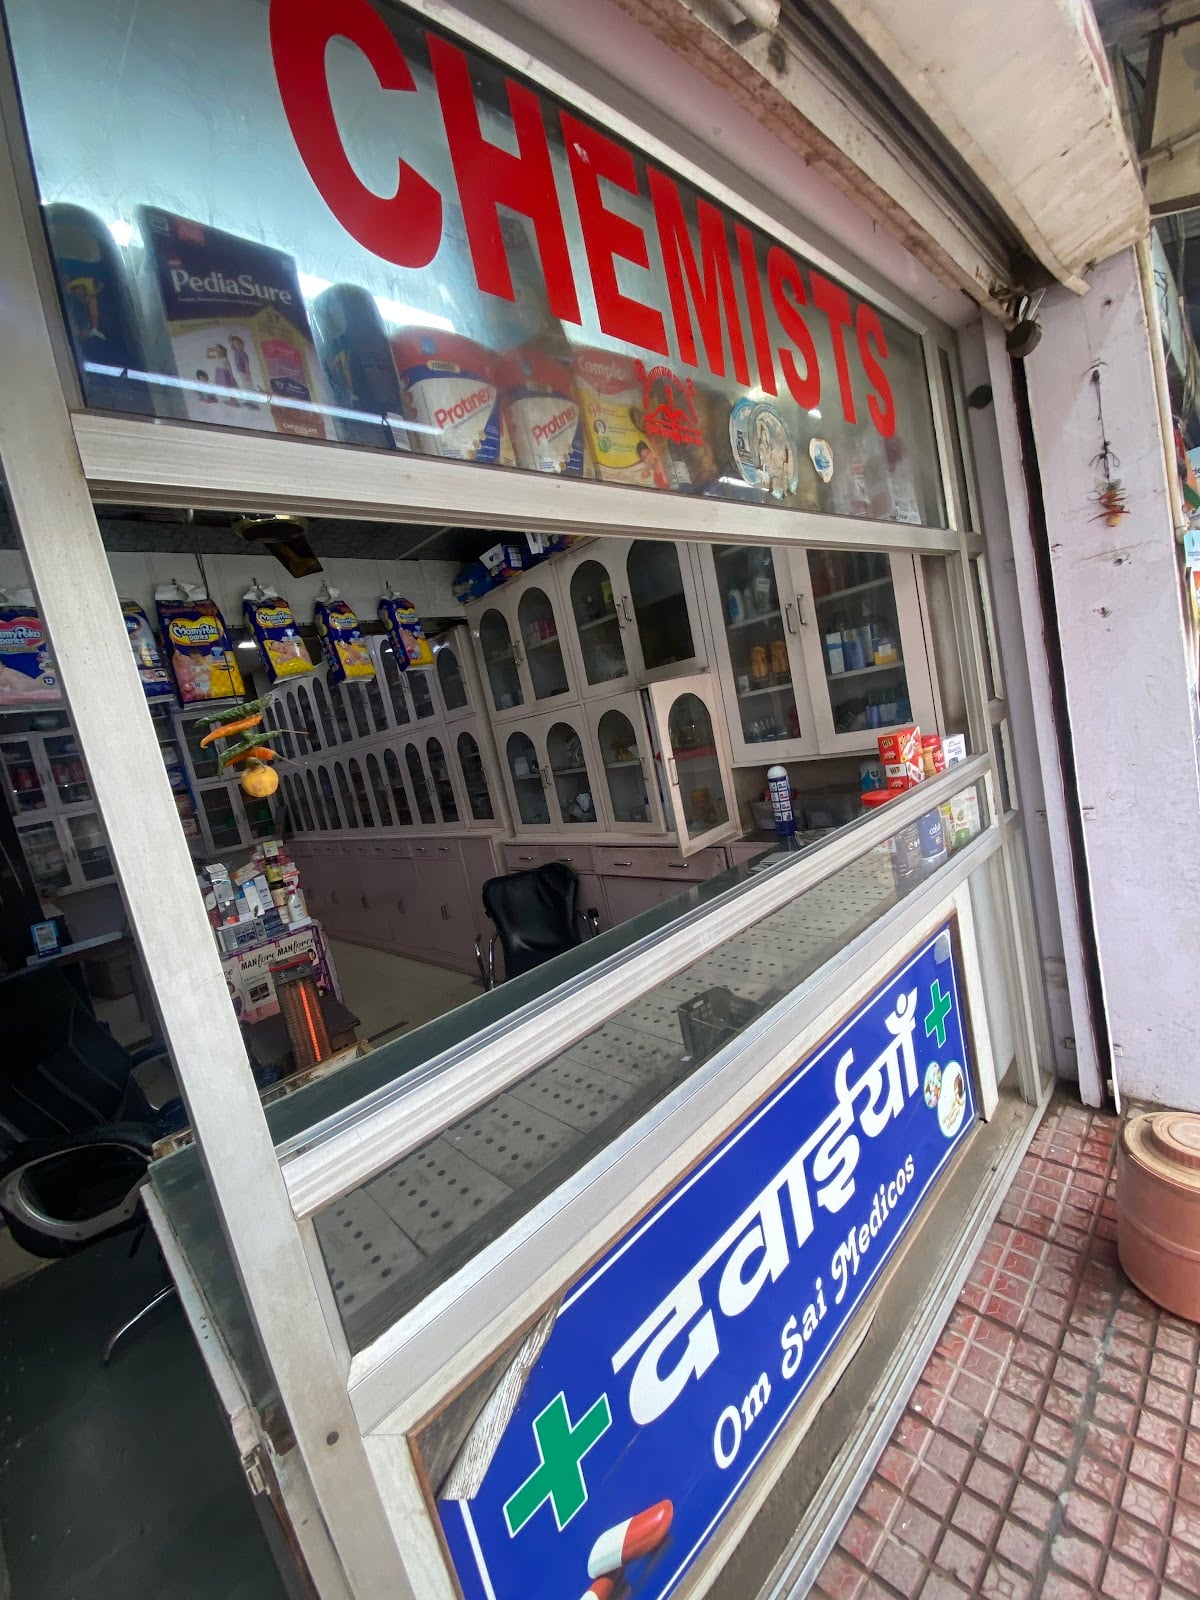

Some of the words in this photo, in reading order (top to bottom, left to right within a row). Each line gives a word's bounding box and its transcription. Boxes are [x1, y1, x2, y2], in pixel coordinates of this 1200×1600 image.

[170, 268, 293, 305] PediaSure
[269, 0, 896, 439] CHEMISTS
[611, 986, 918, 1425] दवाईयाँ
[713, 1371, 771, 1470] Om
[779, 1278, 828, 1378] Sai
[831, 1150, 916, 1304] Medicos
